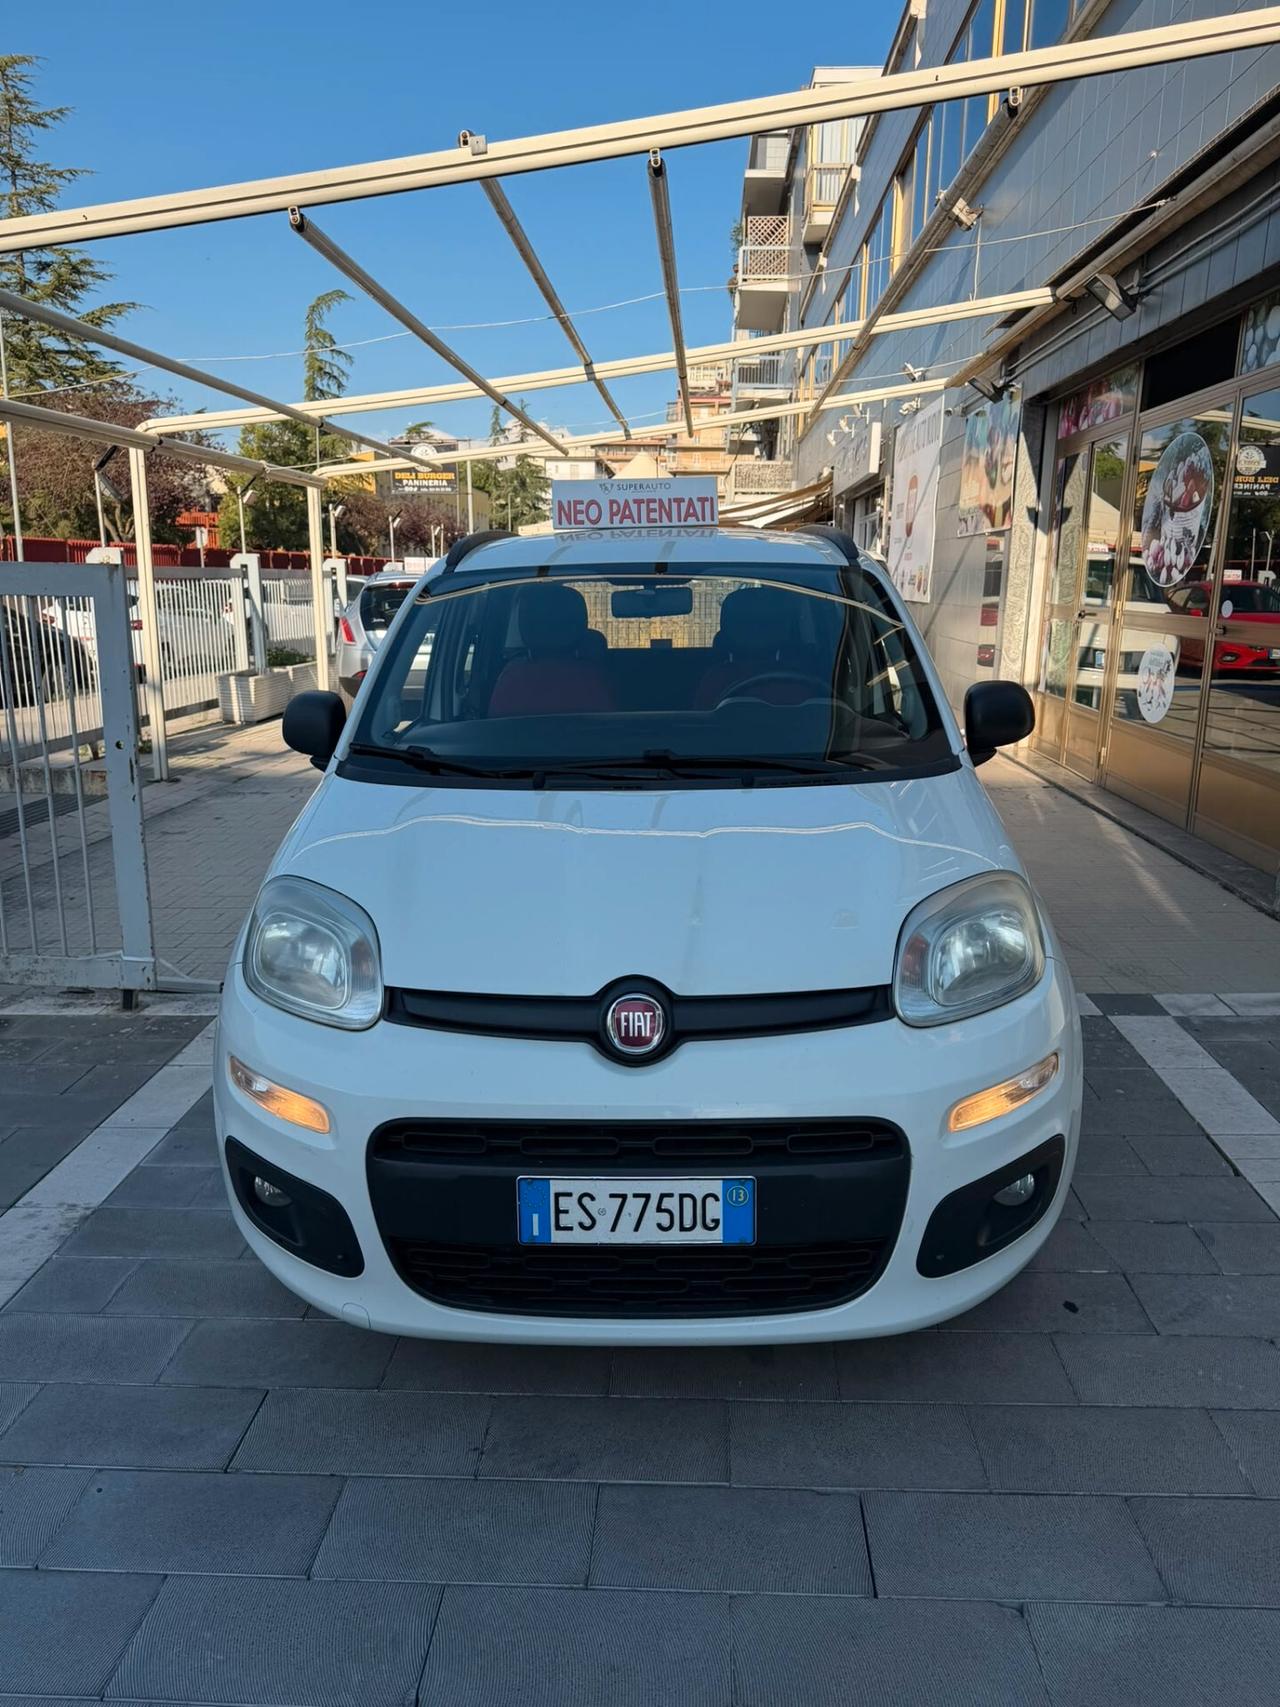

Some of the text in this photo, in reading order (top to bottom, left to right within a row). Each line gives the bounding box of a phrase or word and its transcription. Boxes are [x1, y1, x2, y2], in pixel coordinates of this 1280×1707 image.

[616, 482, 671, 491] SUPERAUTO
[557, 496, 715, 526] NEO PATENTATI
[620, 1011, 654, 1037] FIAT
[730, 1188, 745, 1202] 13
[553, 1192, 721, 1233] ES 775DG
